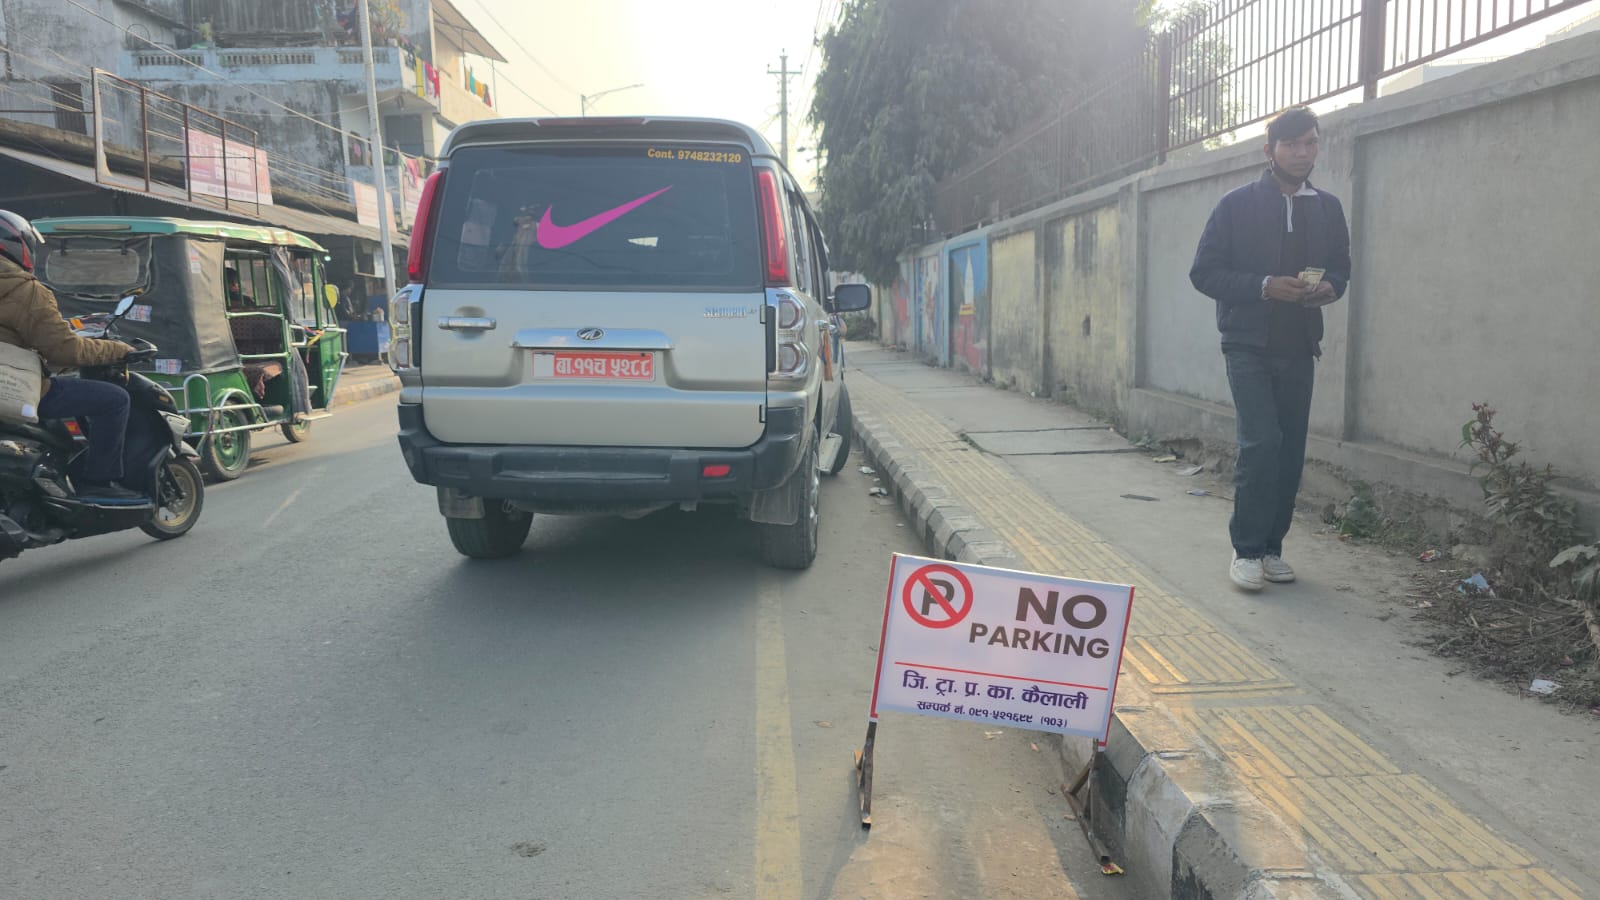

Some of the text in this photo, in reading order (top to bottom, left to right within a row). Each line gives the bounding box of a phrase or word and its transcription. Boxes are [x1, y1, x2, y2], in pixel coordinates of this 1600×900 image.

[647, 148, 742, 163] Cont. 9748232120
[1015, 587, 1107, 630] NO
[969, 622, 1110, 659] PARKING
[902, 669, 929, 690] जि.
[964, 681, 981, 697] प्र.
[987, 684, 1015, 701] का.
[1021, 684, 1089, 710] कैलाली
